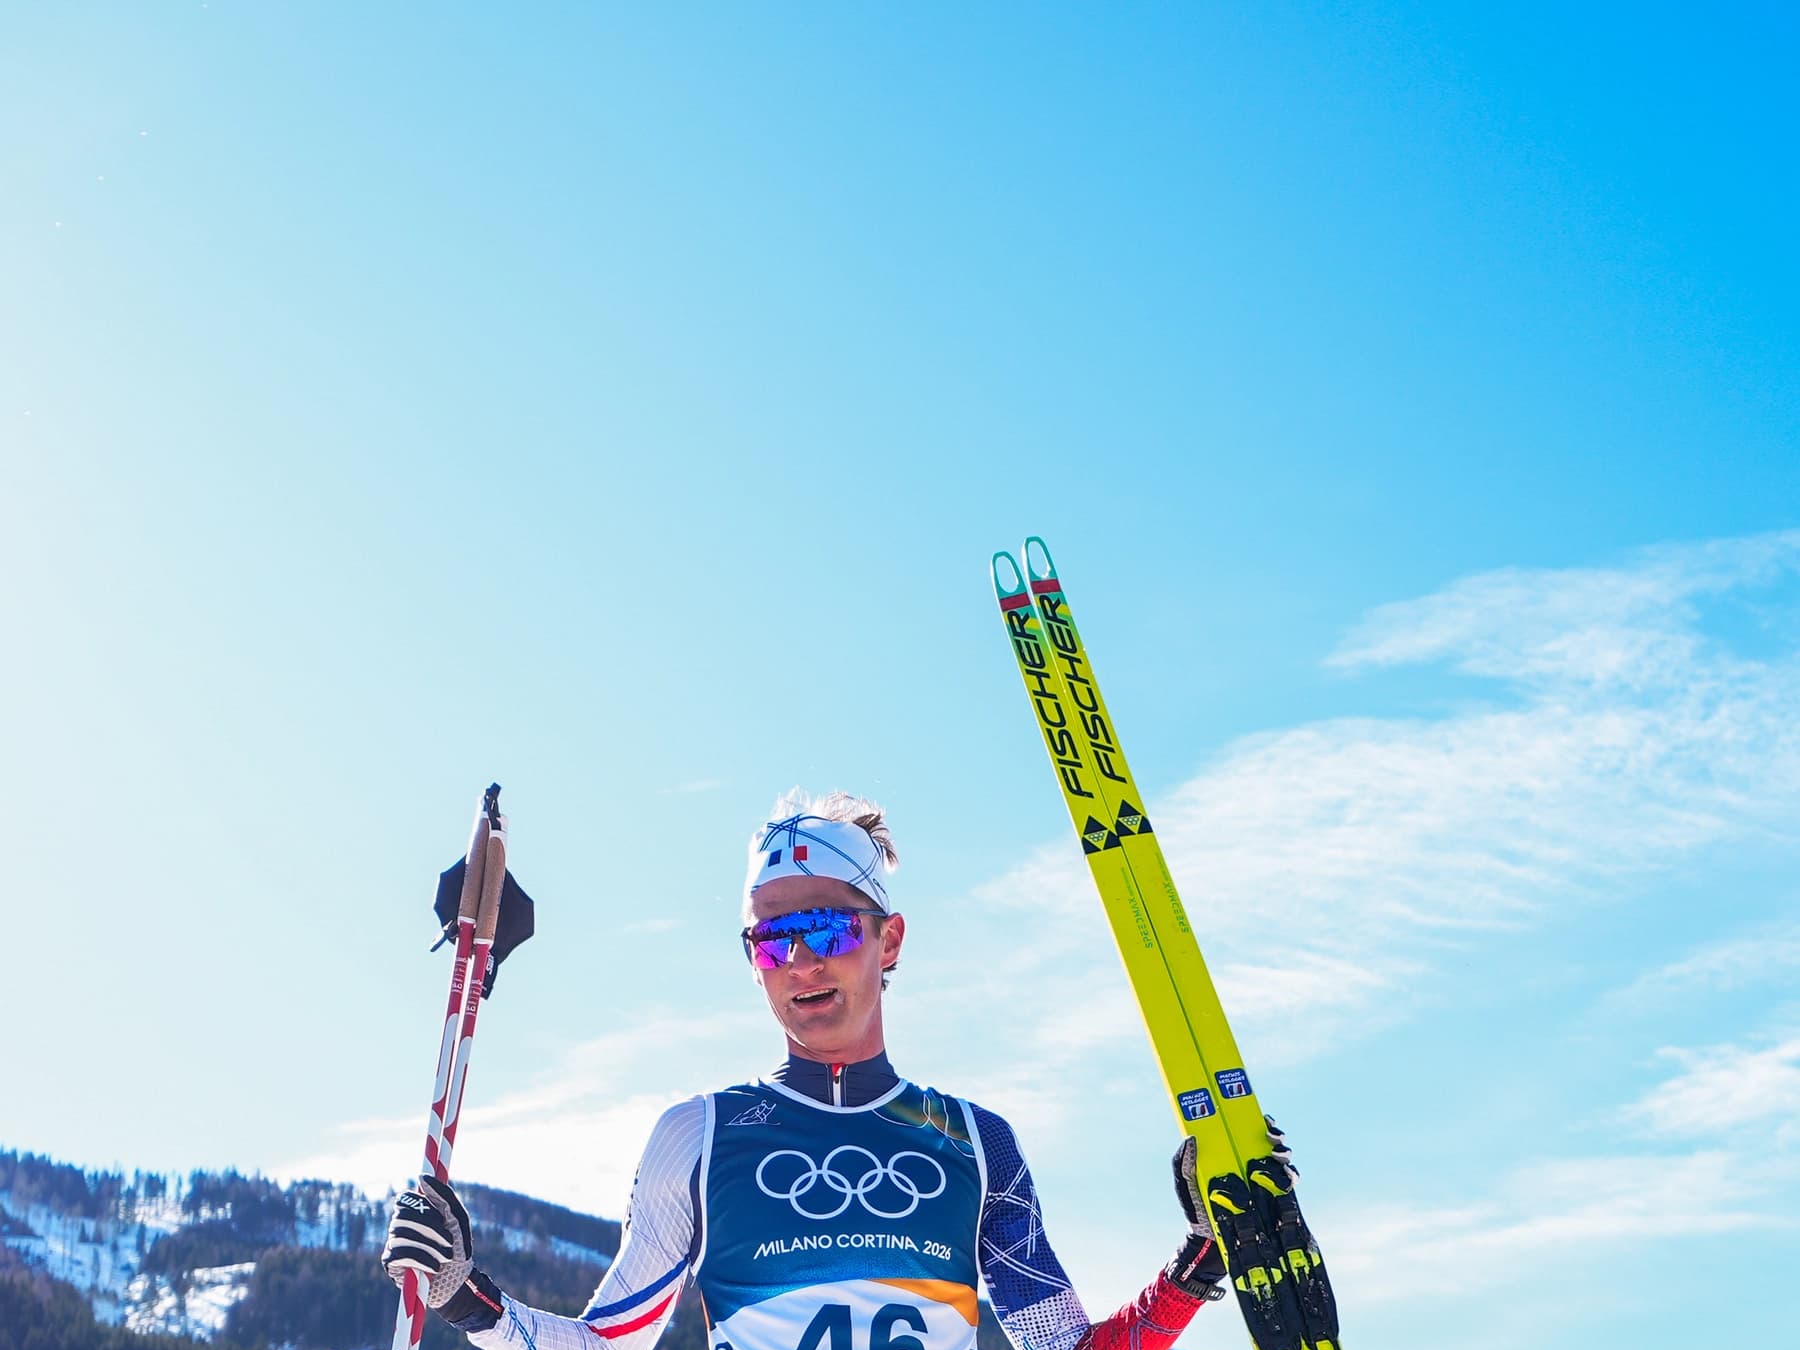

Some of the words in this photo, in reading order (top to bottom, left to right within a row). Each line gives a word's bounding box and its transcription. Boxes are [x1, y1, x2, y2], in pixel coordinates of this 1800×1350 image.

[1007, 610, 1094, 799] FISCHER
[1039, 594, 1128, 784] FISCHER
[1128, 897, 1154, 949] SPEEDMAX
[753, 1234, 833, 1260] MILANO
[836, 1233, 920, 1252] CORTINA
[922, 1240, 952, 1261] 2026
